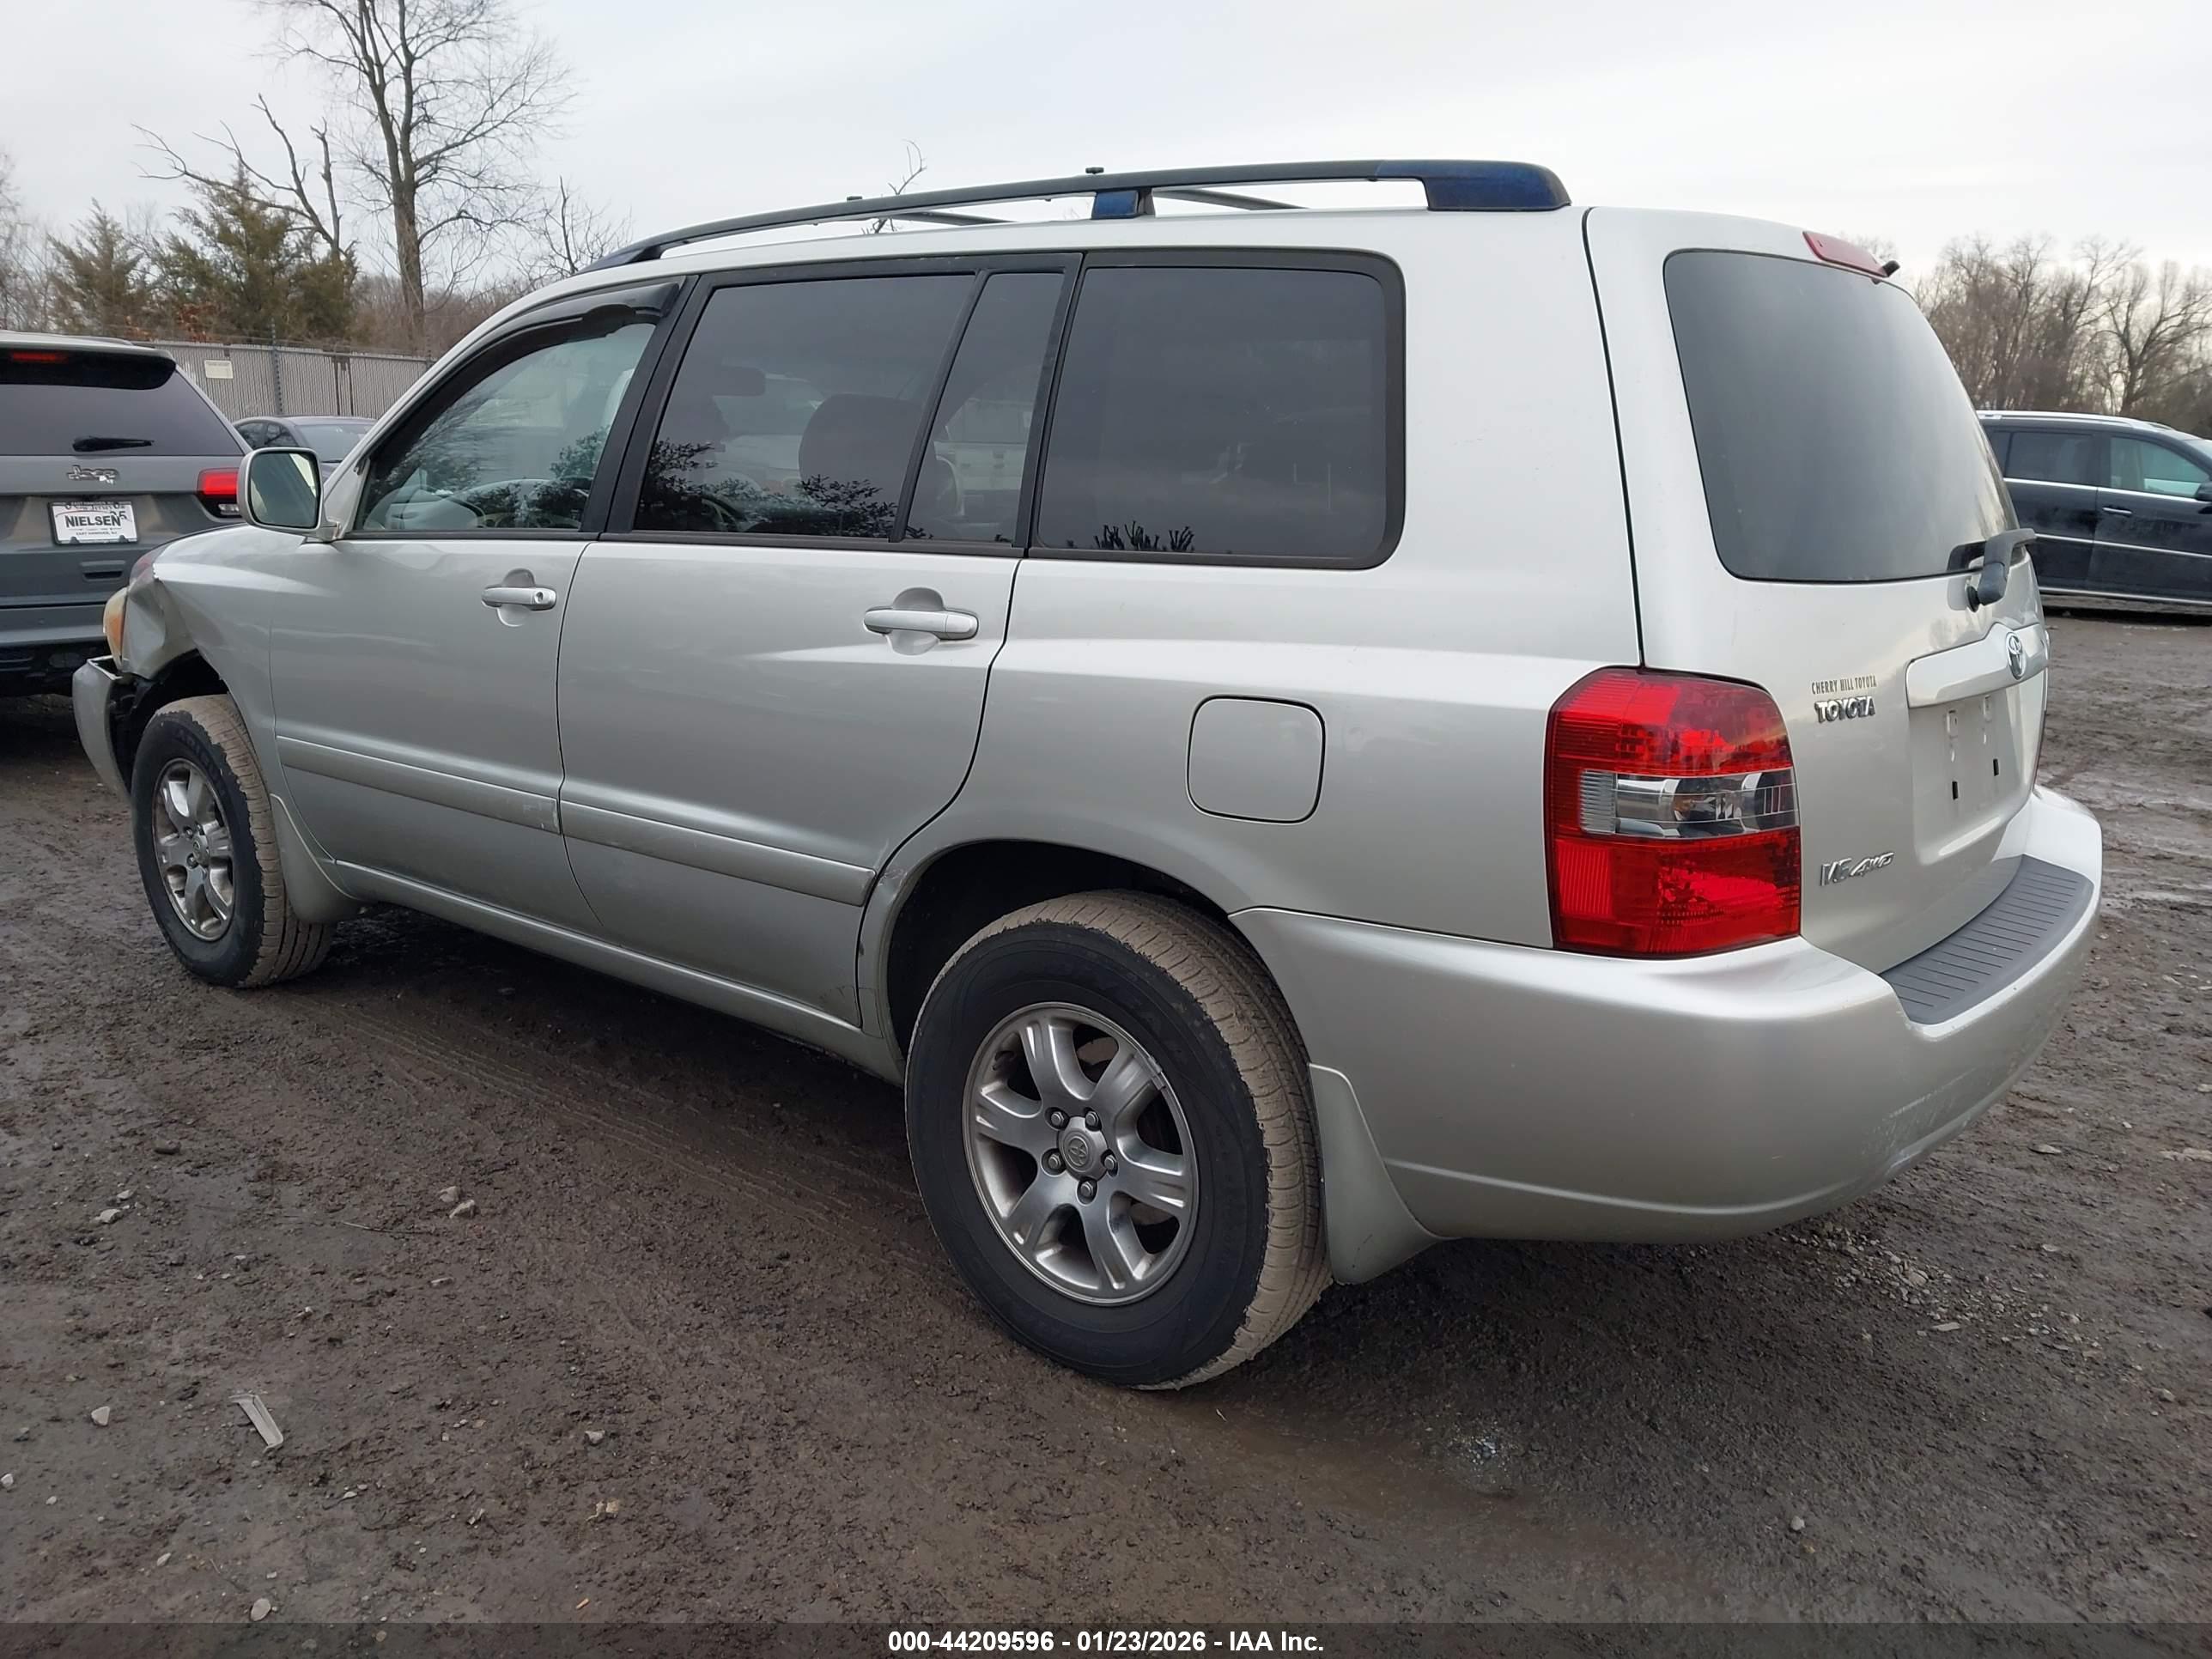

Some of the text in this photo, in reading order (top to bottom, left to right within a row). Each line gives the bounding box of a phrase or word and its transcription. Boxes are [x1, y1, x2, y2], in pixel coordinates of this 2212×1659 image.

[64, 514, 121, 527] NIELSEN
[1811, 675, 1877, 695] CHERRY HILL TOYOTA
[1814, 695, 1876, 723] TOYOTA
